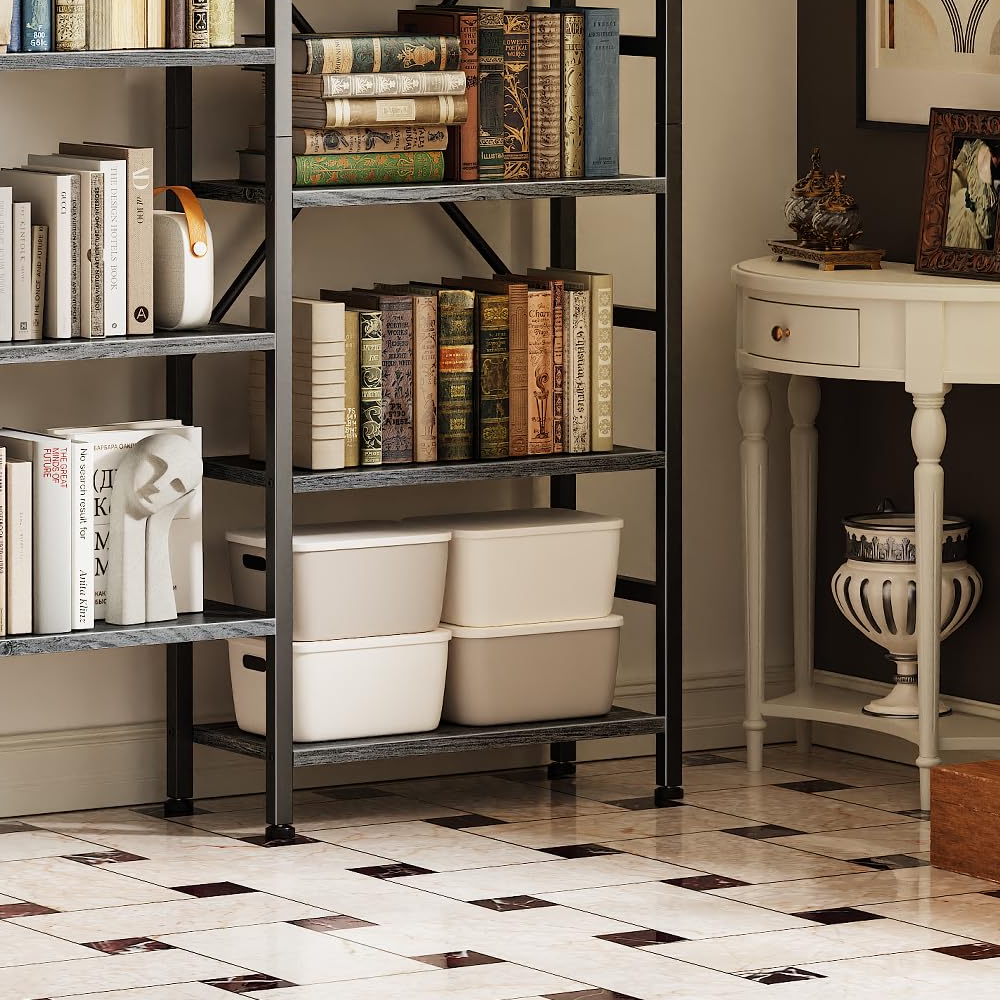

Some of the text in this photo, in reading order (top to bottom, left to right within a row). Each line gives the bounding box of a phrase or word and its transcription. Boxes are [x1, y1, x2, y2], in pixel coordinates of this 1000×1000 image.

[33, 31, 46, 39] 800
[110, 166, 119, 291] THE DESIGN HOTELS BOOK
[43, 448, 52, 478] FUTURE
[52, 447, 60, 484] MINDS OF
[60, 447, 68, 489] THE GREAT
[93, 468, 118, 493] (Д
[79, 447, 88, 540] No search result for
[94, 496, 112, 517] К
[79, 569, 89, 624] Anita Klinz
